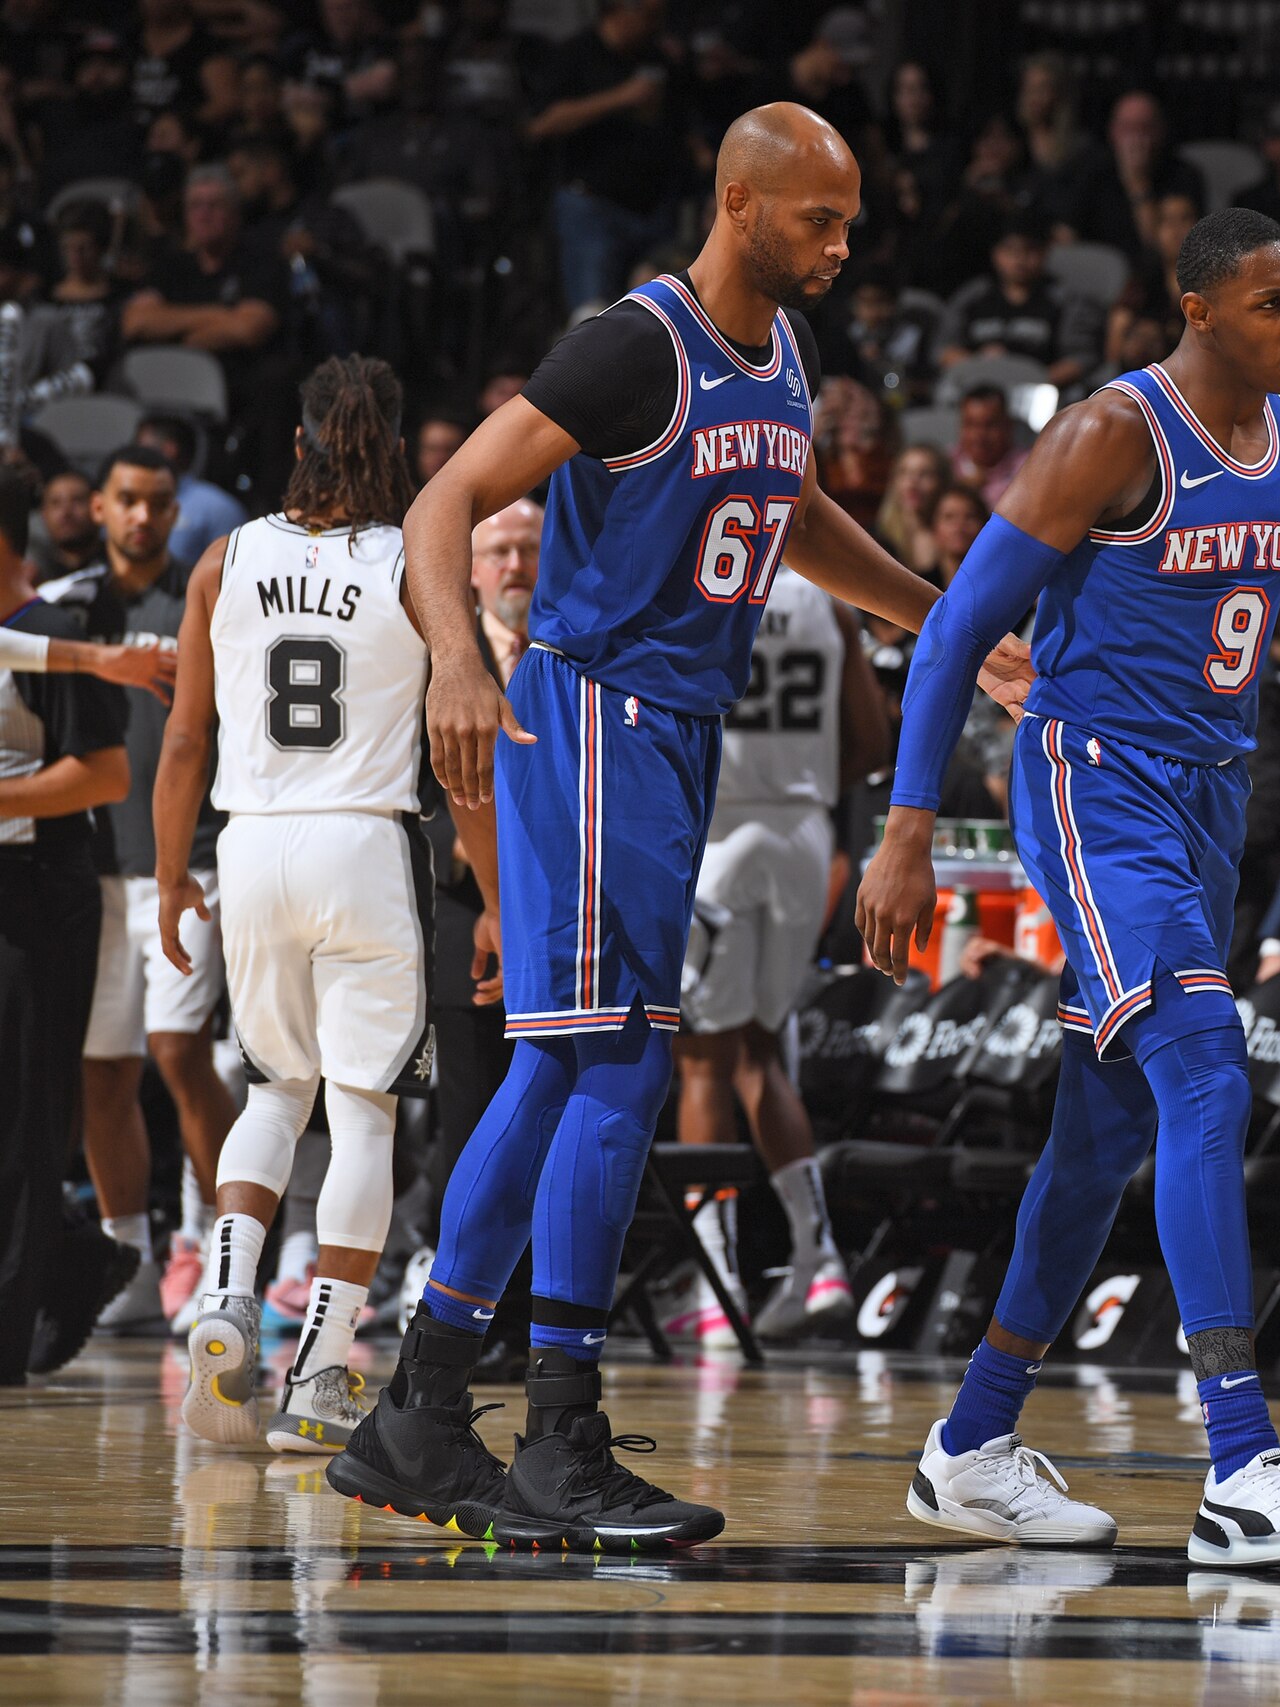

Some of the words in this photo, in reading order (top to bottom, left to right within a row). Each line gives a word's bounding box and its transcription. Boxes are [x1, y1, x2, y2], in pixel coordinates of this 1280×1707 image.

[691, 420, 762, 479] NEW
[694, 494, 800, 604] 67
[1158, 521, 1250, 574] NEW
[256, 576, 362, 622] MILLS
[1203, 586, 1270, 695] 9
[265, 633, 347, 753] 8
[724, 650, 826, 733] 22
